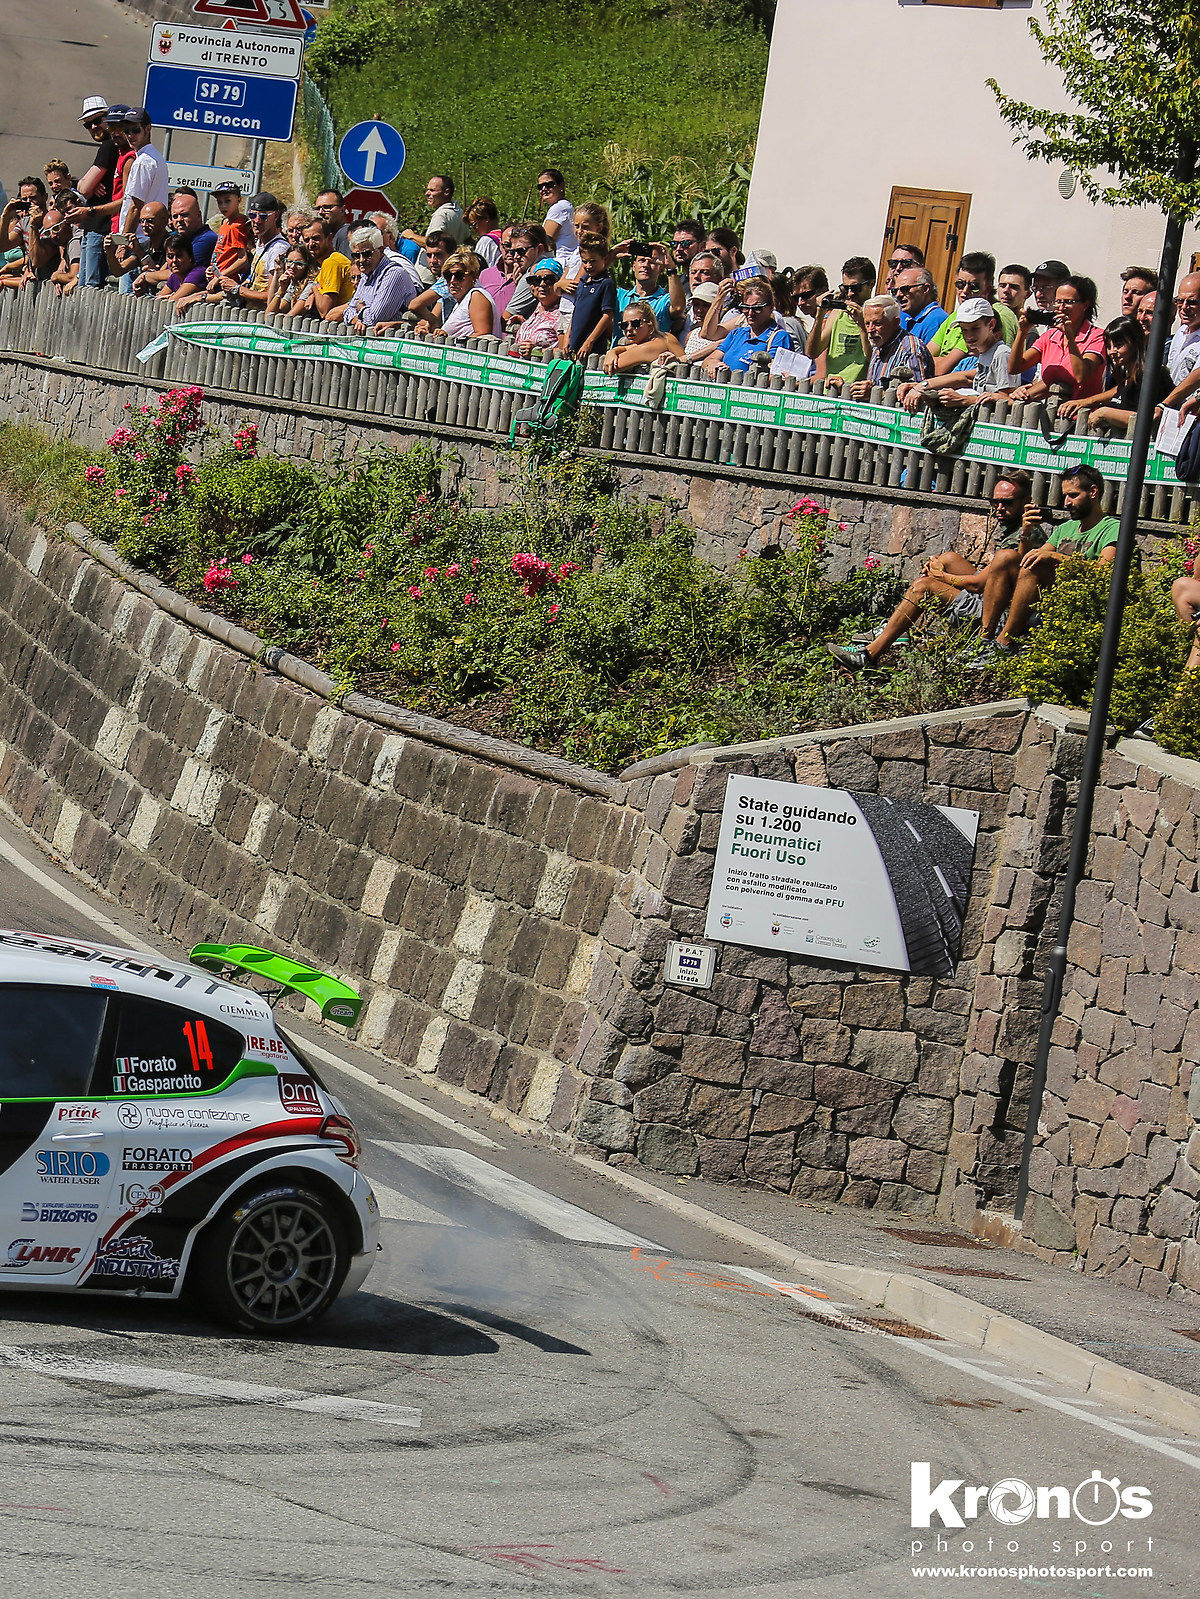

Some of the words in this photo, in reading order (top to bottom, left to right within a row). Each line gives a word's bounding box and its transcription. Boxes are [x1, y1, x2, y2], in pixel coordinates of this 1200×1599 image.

[177, 33, 231, 48] Provincia
[235, 39, 295, 55] Autonoma
[201, 51, 212, 61] di
[216, 53, 268, 67] TRENTO
[200, 82, 219, 98] SP
[223, 85, 241, 101] 79
[173, 108, 198, 122] del
[203, 110, 261, 129] Brocon
[177, 177, 212, 189] serafina
[738, 795, 779, 814] State
[782, 801, 858, 826] guidando
[735, 814, 754, 826] su
[760, 816, 801, 833] 1.200
[733, 827, 822, 852] Pneumatici
[730, 843, 770, 860] Fuori
[775, 849, 807, 866] Uso
[728, 867, 748, 877] Inizio
[749, 871, 769, 880] tratto
[771, 873, 801, 885] stradale
[802, 880, 838, 891] realizzato
[741, 877, 767, 888] asfalto
[768, 882, 807, 894] modificato
[740, 886, 775, 897] polverino
[785, 894, 813, 903] gomma
[825, 898, 845, 908] PFU
[685, 947, 705, 956] P.A.T.
[219, 1004, 270, 1020] CIEMMEVI
[182, 1020, 214, 1071] 14
[130, 1056, 177, 1073] Forato
[127, 1074, 202, 1094] Gasparotto
[280, 1076, 317, 1101] bm
[58, 1108, 101, 1121] prink
[145, 1107, 184, 1118] nuova
[188, 1108, 251, 1122] confezione
[35, 1150, 97, 1176] SIRIO
[122, 1147, 193, 1161] FORATO
[124, 1162, 191, 1171] TRASPORTI
[40, 1176, 70, 1184] WATER
[72, 1177, 100, 1185] LASER
[40, 1209, 98, 1223] BIZZOTTO
[15, 1245, 81, 1263] LAMEC
